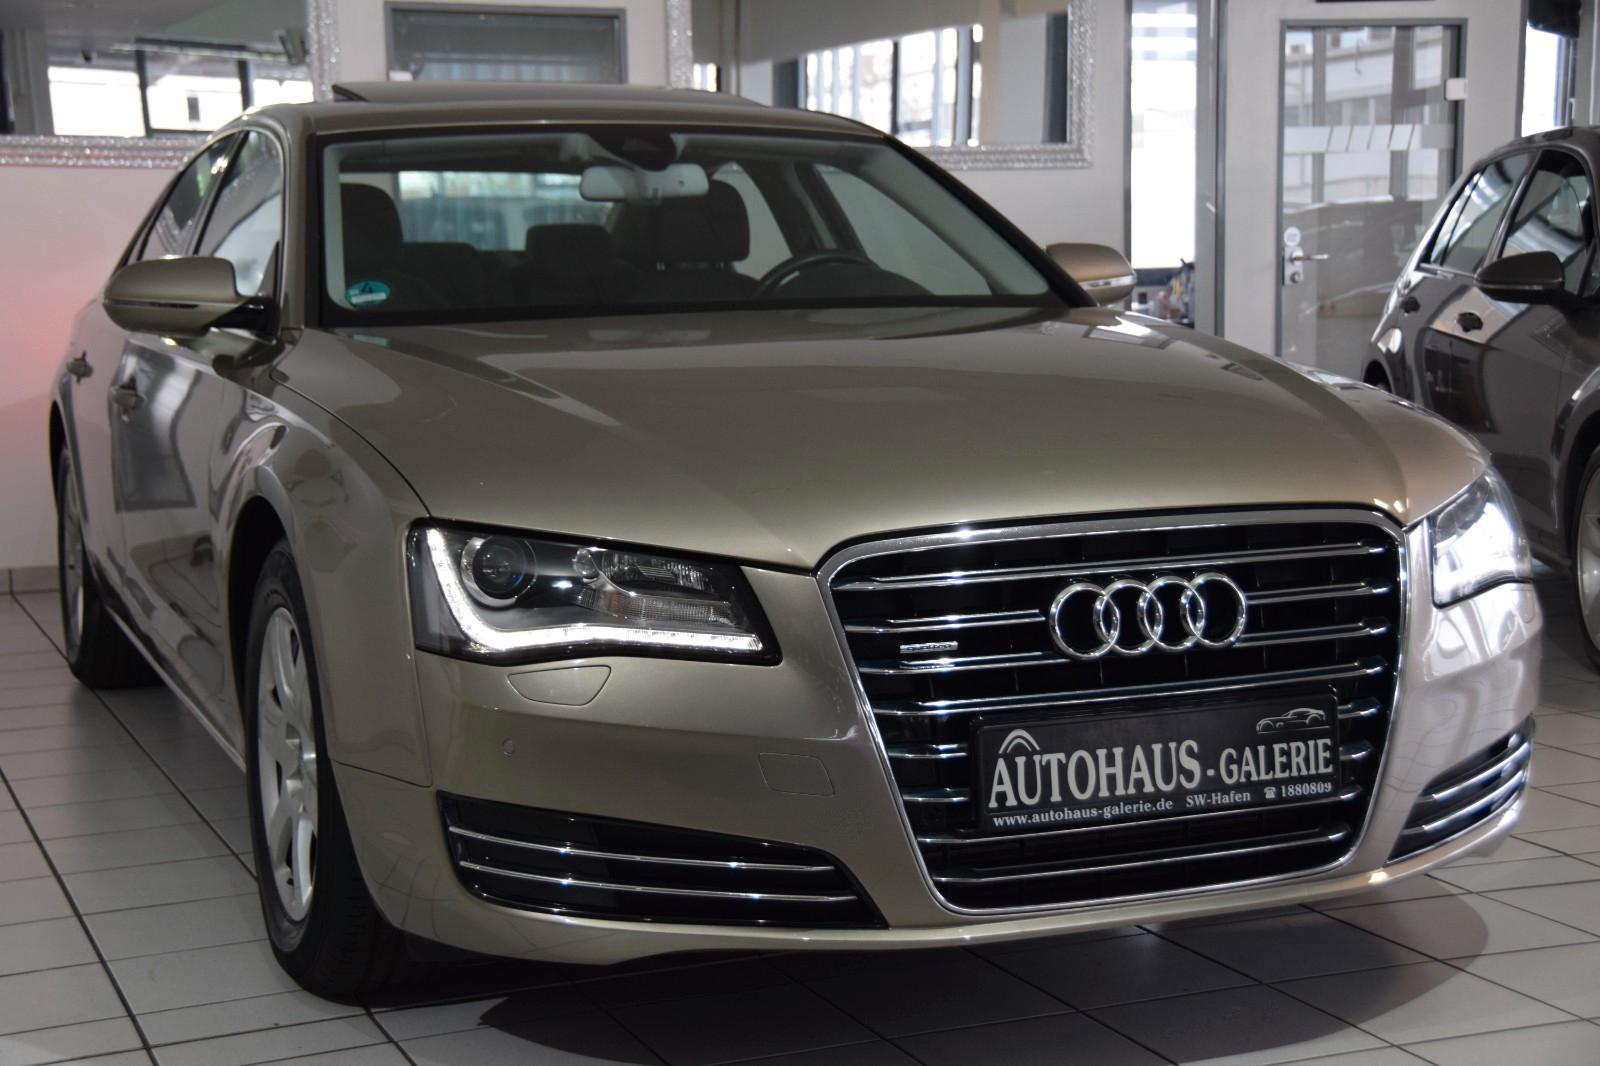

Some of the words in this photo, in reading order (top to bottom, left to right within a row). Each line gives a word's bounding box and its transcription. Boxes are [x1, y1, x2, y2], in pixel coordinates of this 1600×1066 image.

[993, 797, 1174, 827] www.autohaus-galerie.de
[1185, 790, 1251, 808] SW-Hafen
[1281, 781, 1332, 798] 1880809
